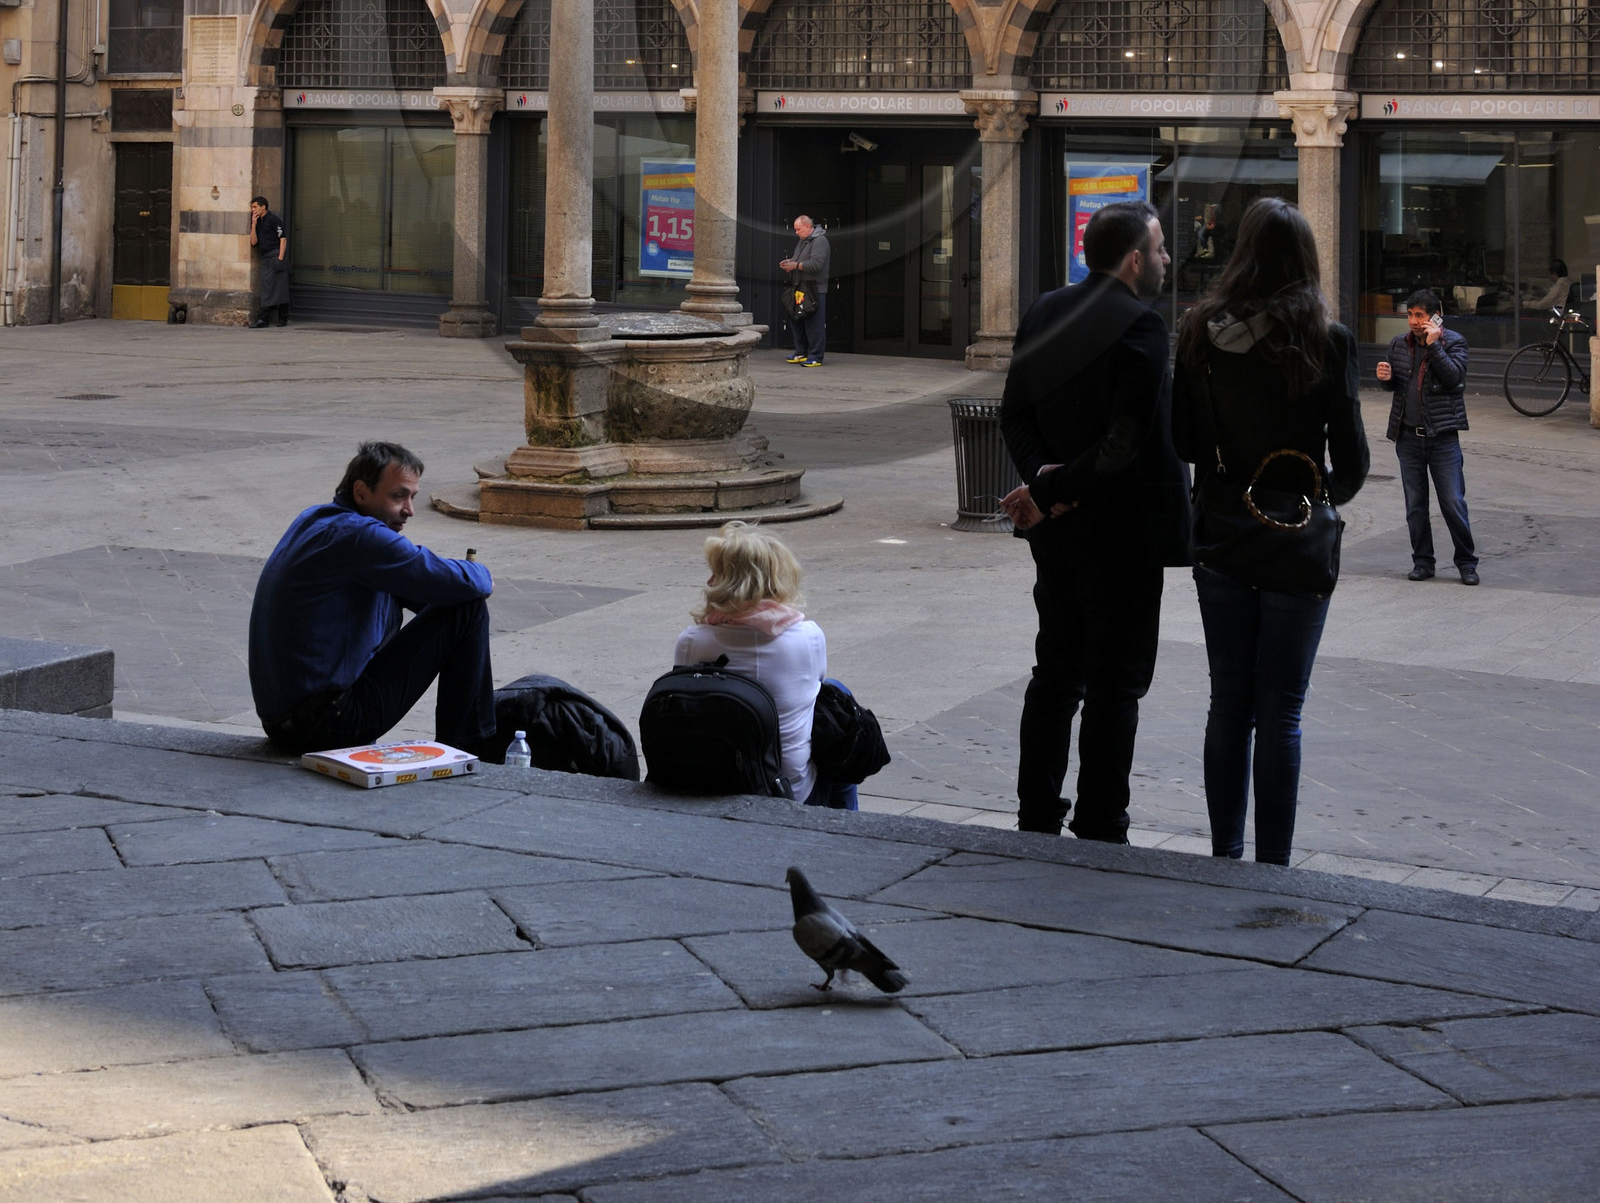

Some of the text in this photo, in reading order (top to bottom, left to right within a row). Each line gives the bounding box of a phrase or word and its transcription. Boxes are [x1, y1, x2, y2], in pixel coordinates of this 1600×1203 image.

[307, 93, 440, 107] BANCA POPOLARE DI LO
[593, 96, 638, 108] POLARE
[661, 96, 686, 108] LOD
[787, 96, 965, 110] BANCA POPOLARE DI LOD
[1071, 99, 1123, 111] BANCA
[1130, 99, 1212, 112] POPOLARE
[1220, 100, 1234, 112] DI
[1401, 100, 1592, 115] BANCA POPOLARE DI
[651, 194, 669, 203] Mutuo
[1080, 200, 1101, 209] Mutuo
[649, 215, 694, 242] 1,15
[396, 768, 453, 783] PIZZA PIZZA
